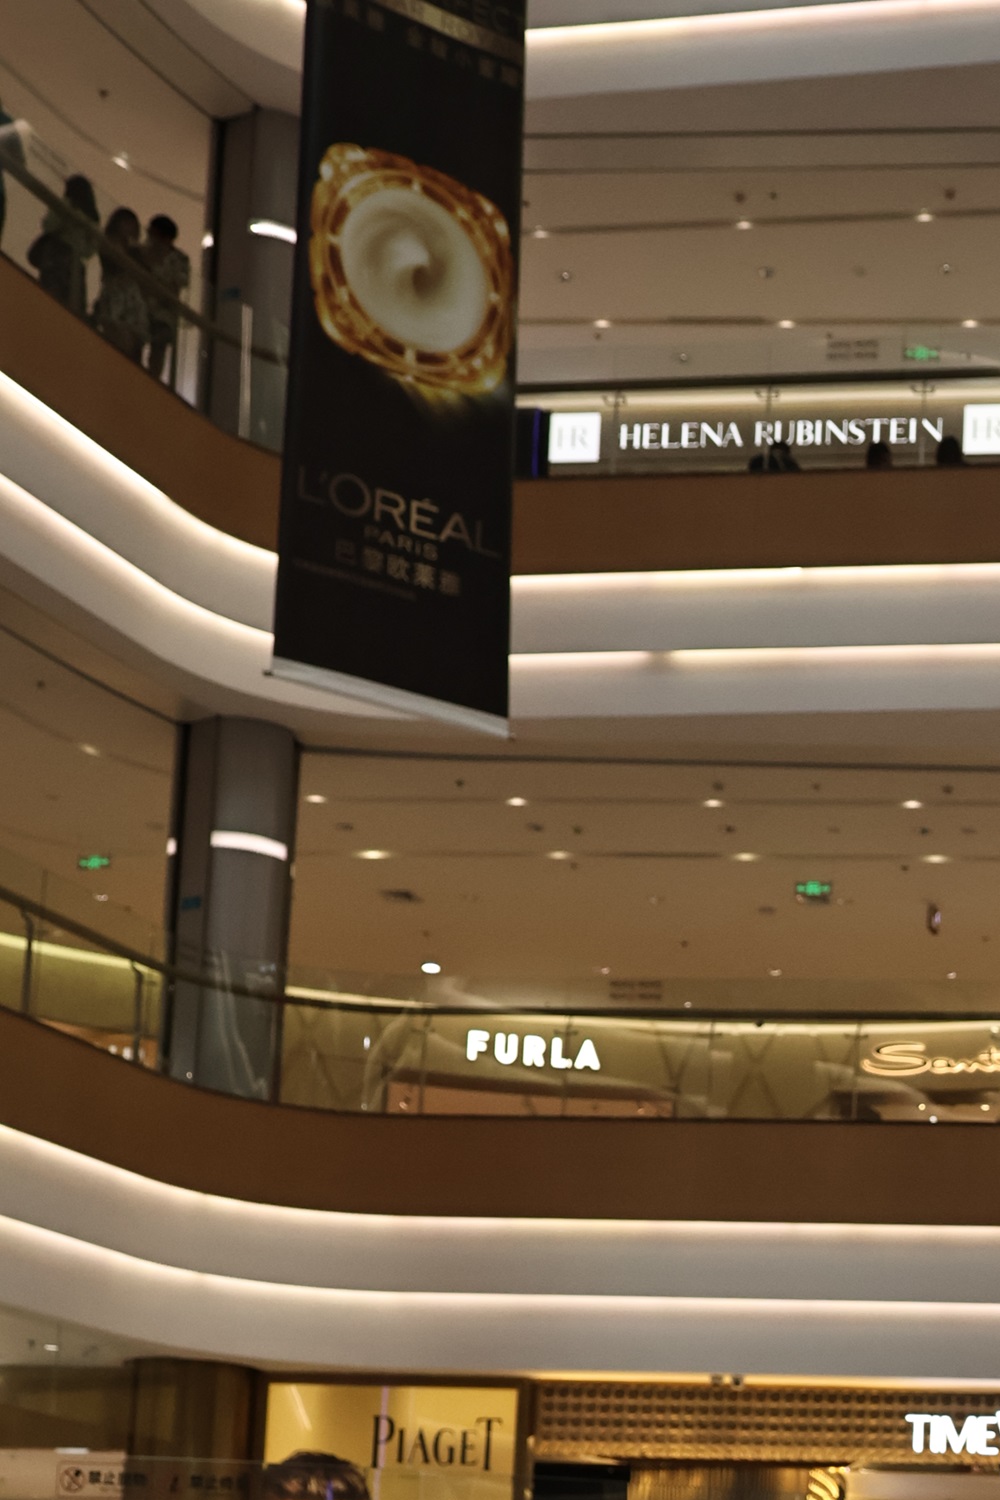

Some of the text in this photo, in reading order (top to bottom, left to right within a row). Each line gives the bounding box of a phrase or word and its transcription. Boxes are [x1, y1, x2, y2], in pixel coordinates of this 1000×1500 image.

[618, 416, 944, 450] HELENA RUBINSTEIN
[466, 1029, 601, 1071] FURLA
